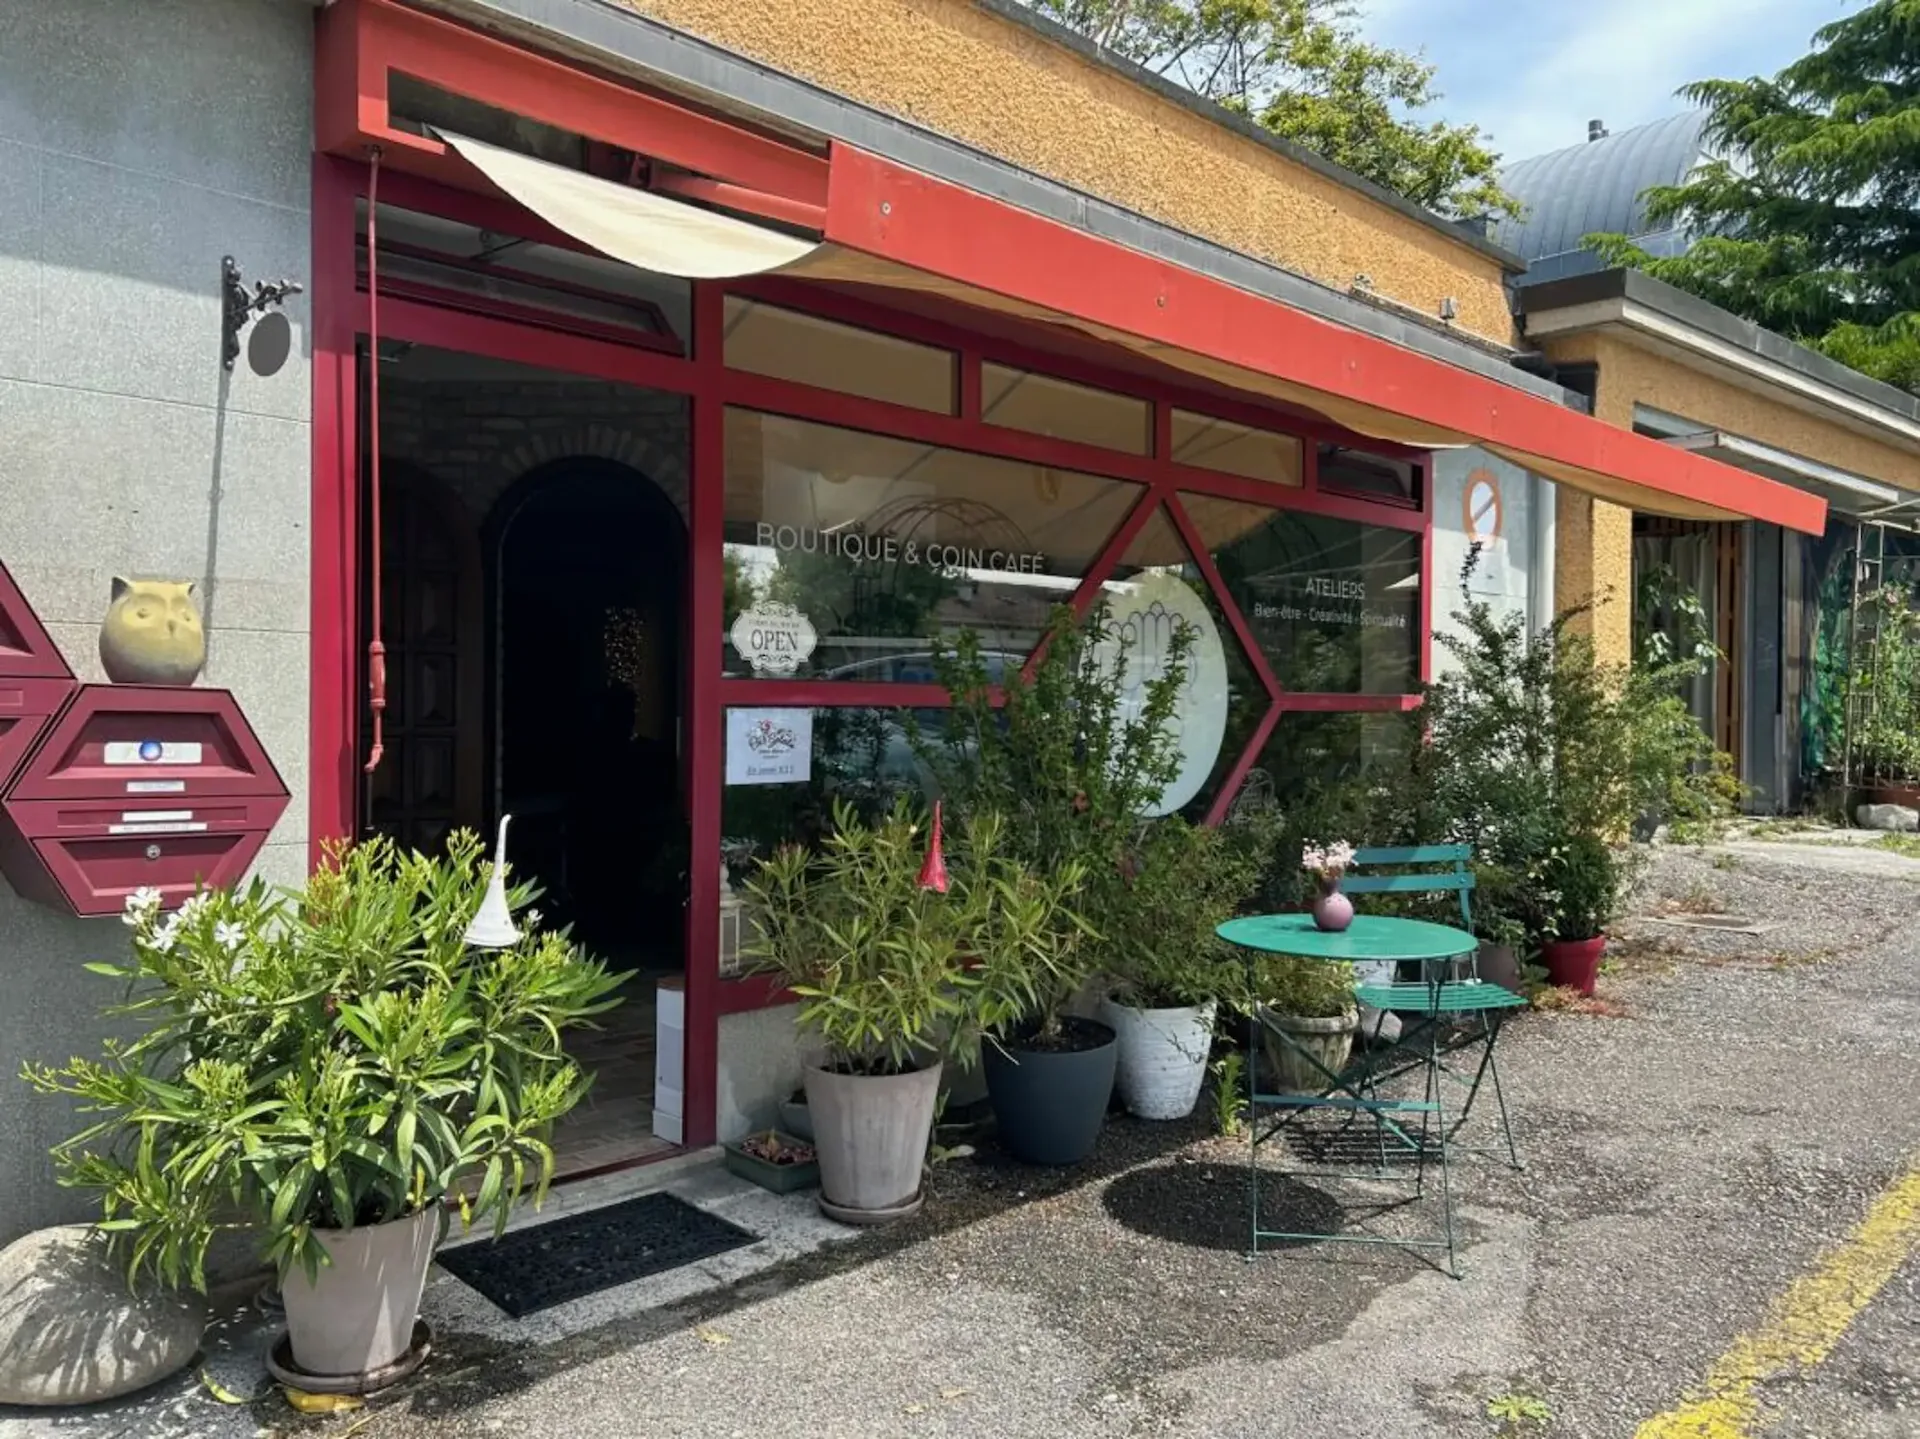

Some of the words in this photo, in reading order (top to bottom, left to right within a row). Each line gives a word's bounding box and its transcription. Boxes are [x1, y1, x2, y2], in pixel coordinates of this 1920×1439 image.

[756, 522, 899, 563] BOUTIQUE
[904, 540, 920, 565] &
[926, 544, 983, 571] COIN
[989, 551, 1045, 574] CAFÉ
[1305, 577, 1365, 600] ATELIERS
[751, 629, 798, 651] OPEN
